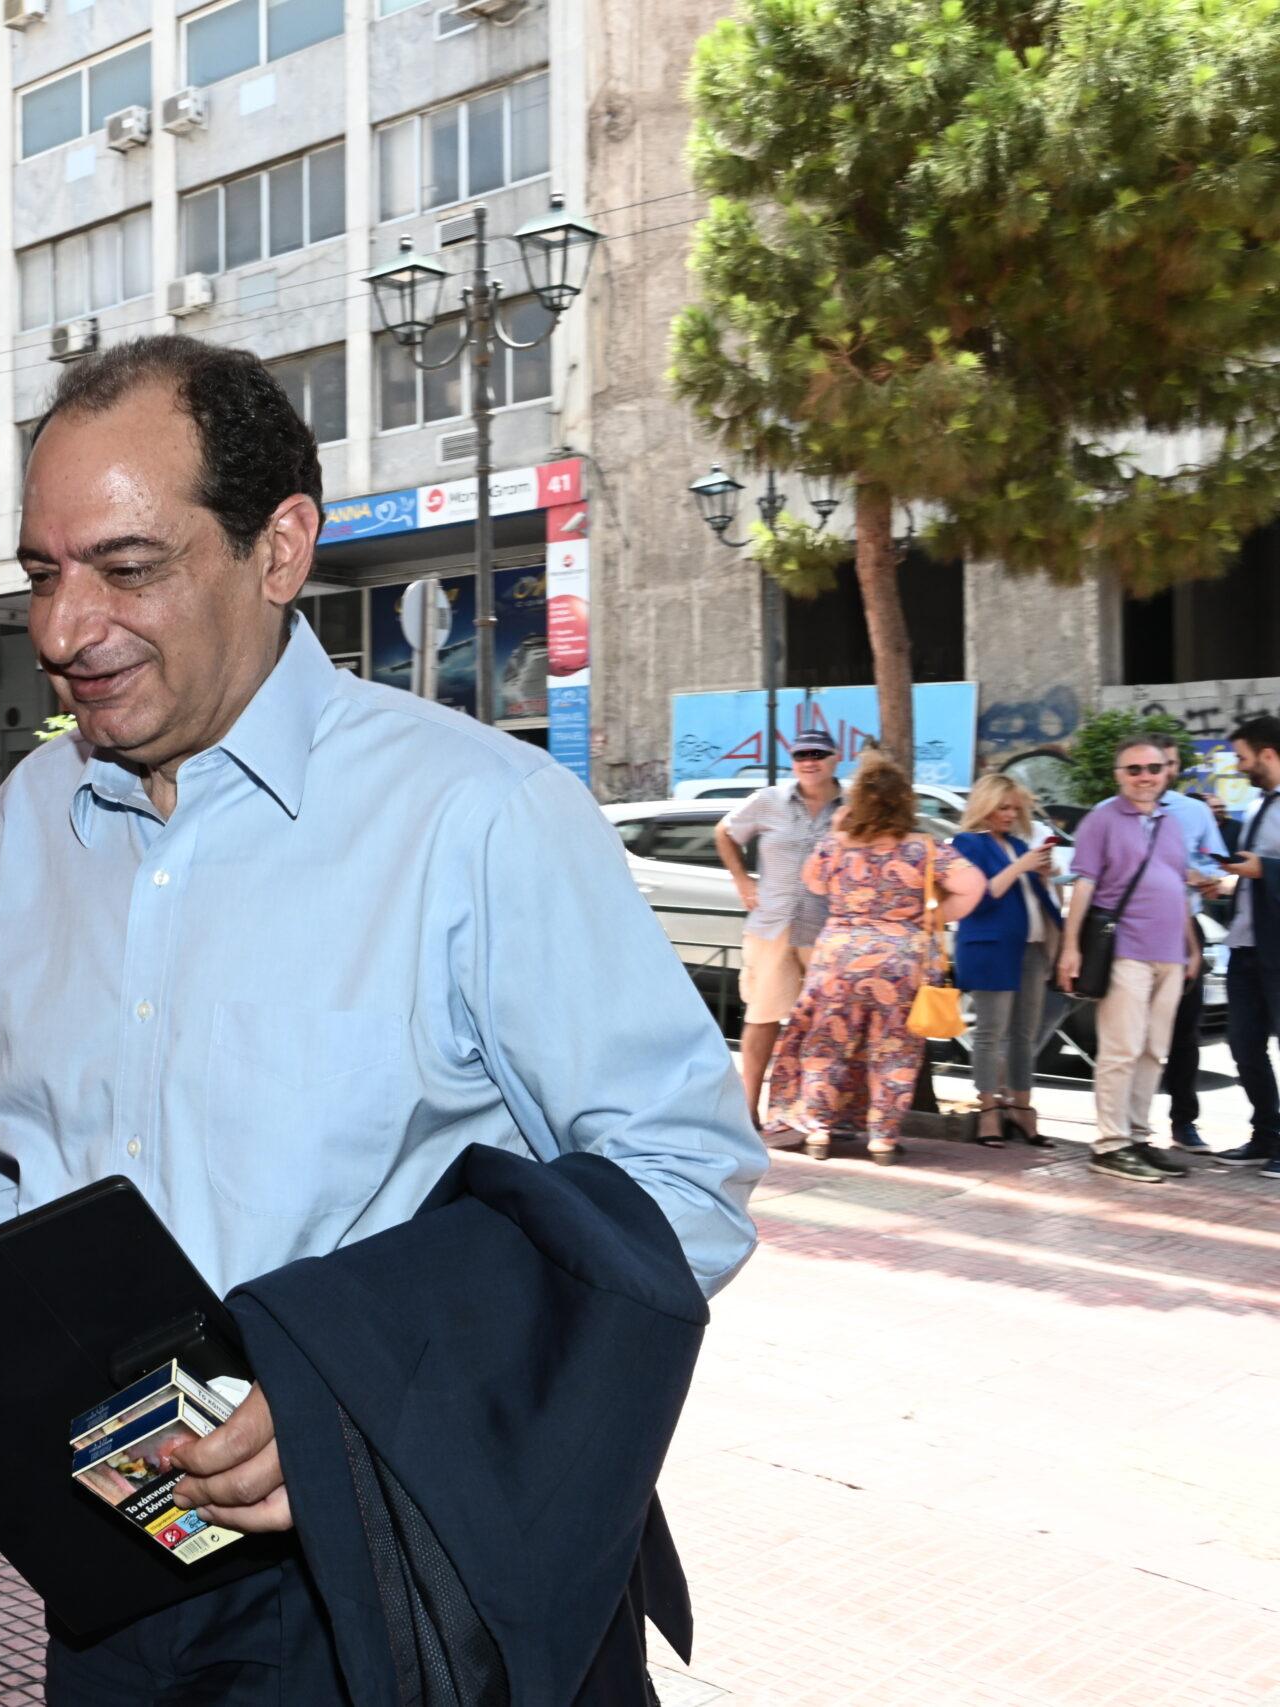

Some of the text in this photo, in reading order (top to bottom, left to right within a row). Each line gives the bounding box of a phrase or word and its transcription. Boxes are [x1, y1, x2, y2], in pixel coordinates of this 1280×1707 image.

[448, 474, 571, 504] MonGram 41
[125, 1480, 177, 1515] Το κάπνισμα
[135, 1511, 149, 1521] τα
